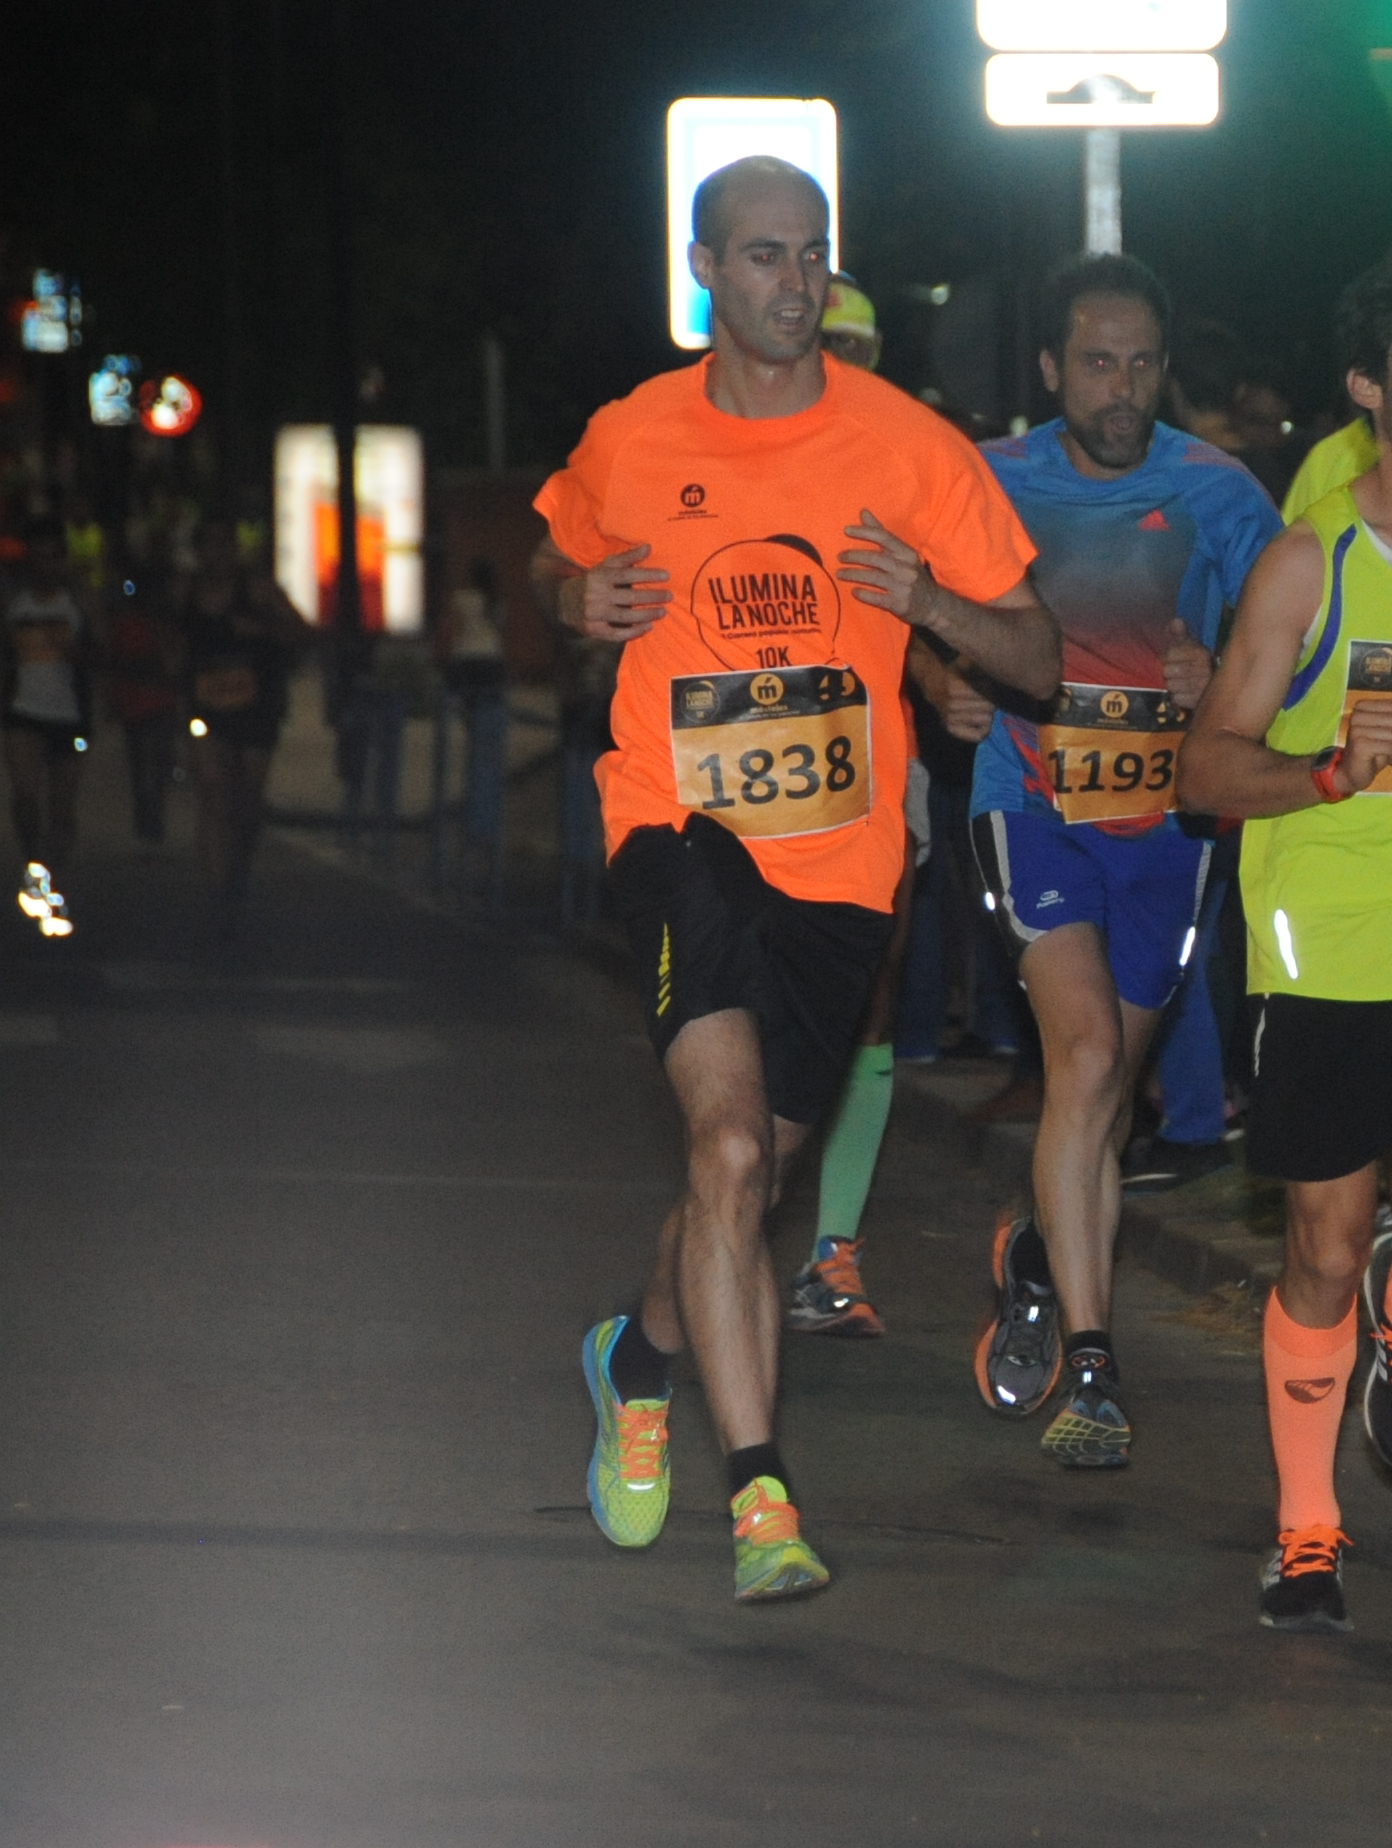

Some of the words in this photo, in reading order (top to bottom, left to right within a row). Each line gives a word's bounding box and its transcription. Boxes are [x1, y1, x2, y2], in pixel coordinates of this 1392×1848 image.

[708, 573, 817, 605] ILUMINA
[716, 603, 745, 630] LA
[746, 601, 820, 628] NOCHE
[755, 646, 791, 669] 10K
[697, 735, 856, 810] 1838
[1048, 749, 1175, 794] 1193
